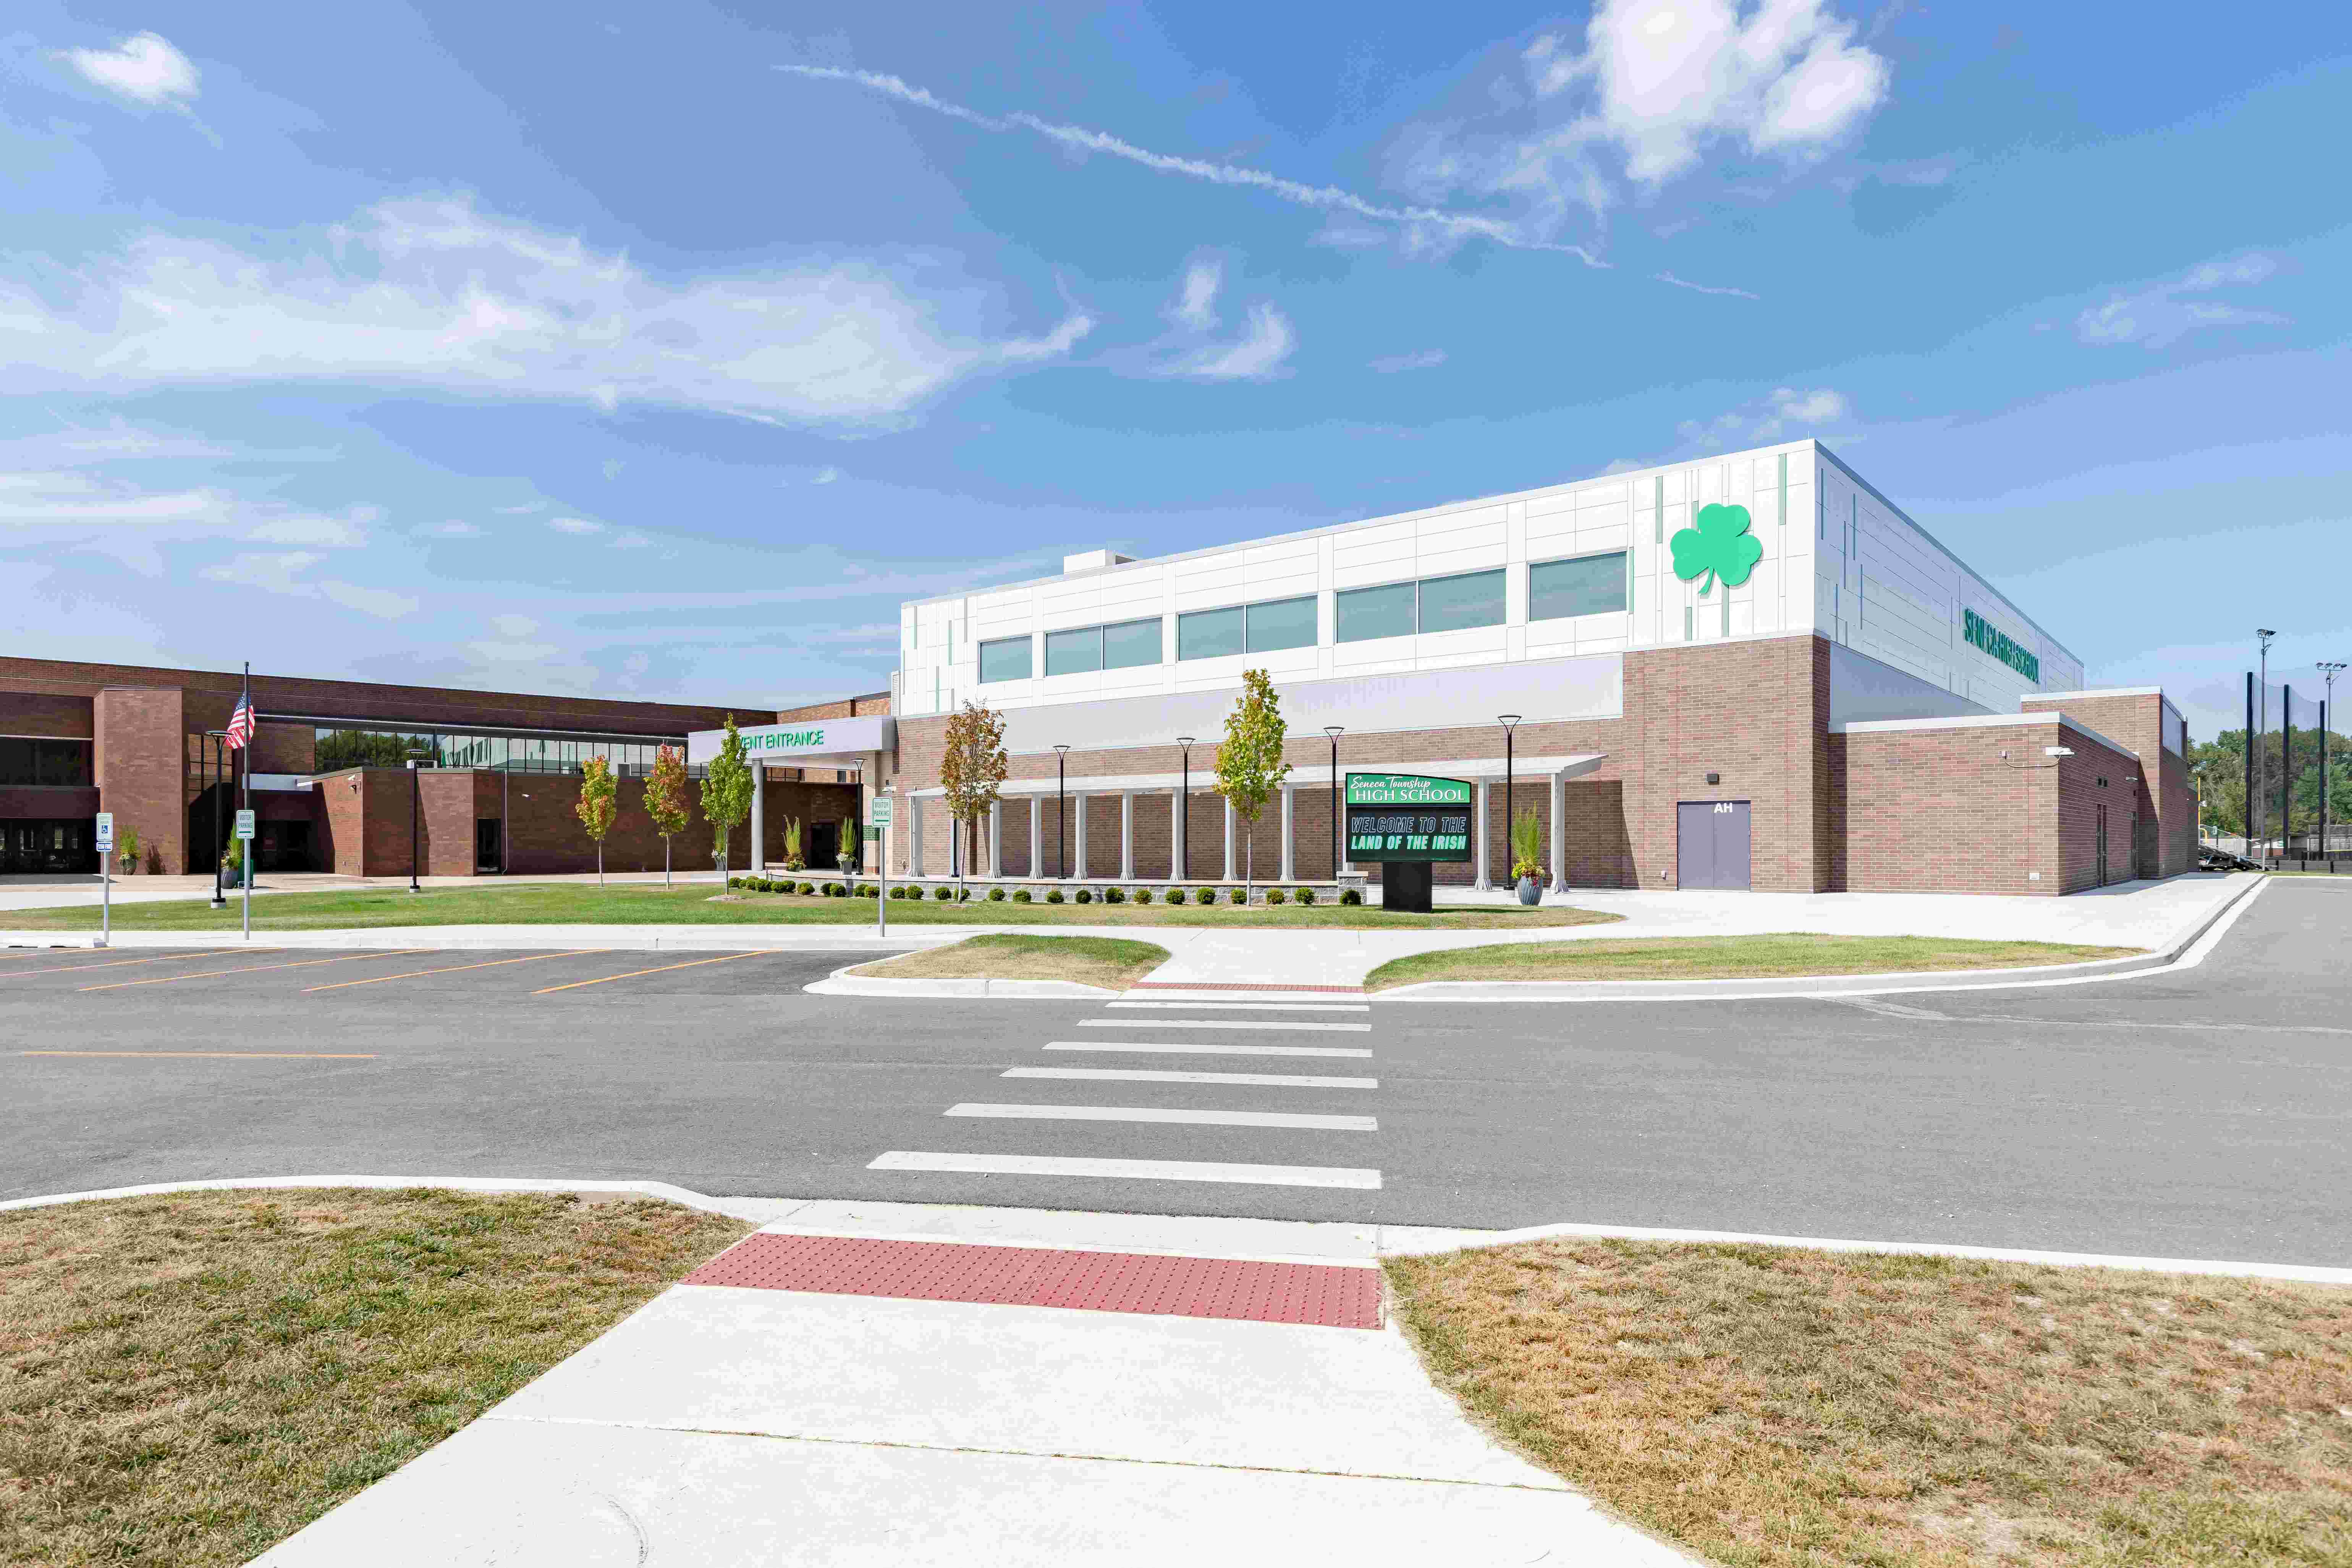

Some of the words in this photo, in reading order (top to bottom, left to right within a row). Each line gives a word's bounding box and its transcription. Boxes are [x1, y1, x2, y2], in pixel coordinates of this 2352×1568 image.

[739, 735, 763, 750] VENT
[766, 730, 824, 749] ENTRANCE
[1351, 776, 1386, 789] Seneca
[1385, 777, 1431, 792] Township
[1356, 790, 1395, 801] HIGH
[1400, 789, 1465, 801] SCHOOL
[1714, 803, 1733, 813] AH
[1351, 817, 1414, 833] WELCOME
[1419, 817, 1436, 833] TO
[1441, 817, 1466, 833] THE
[1351, 835, 1383, 850] LAND
[1387, 835, 1402, 850] OF
[1407, 835, 1428, 850] THE
[1432, 835, 1466, 850] IRISH
